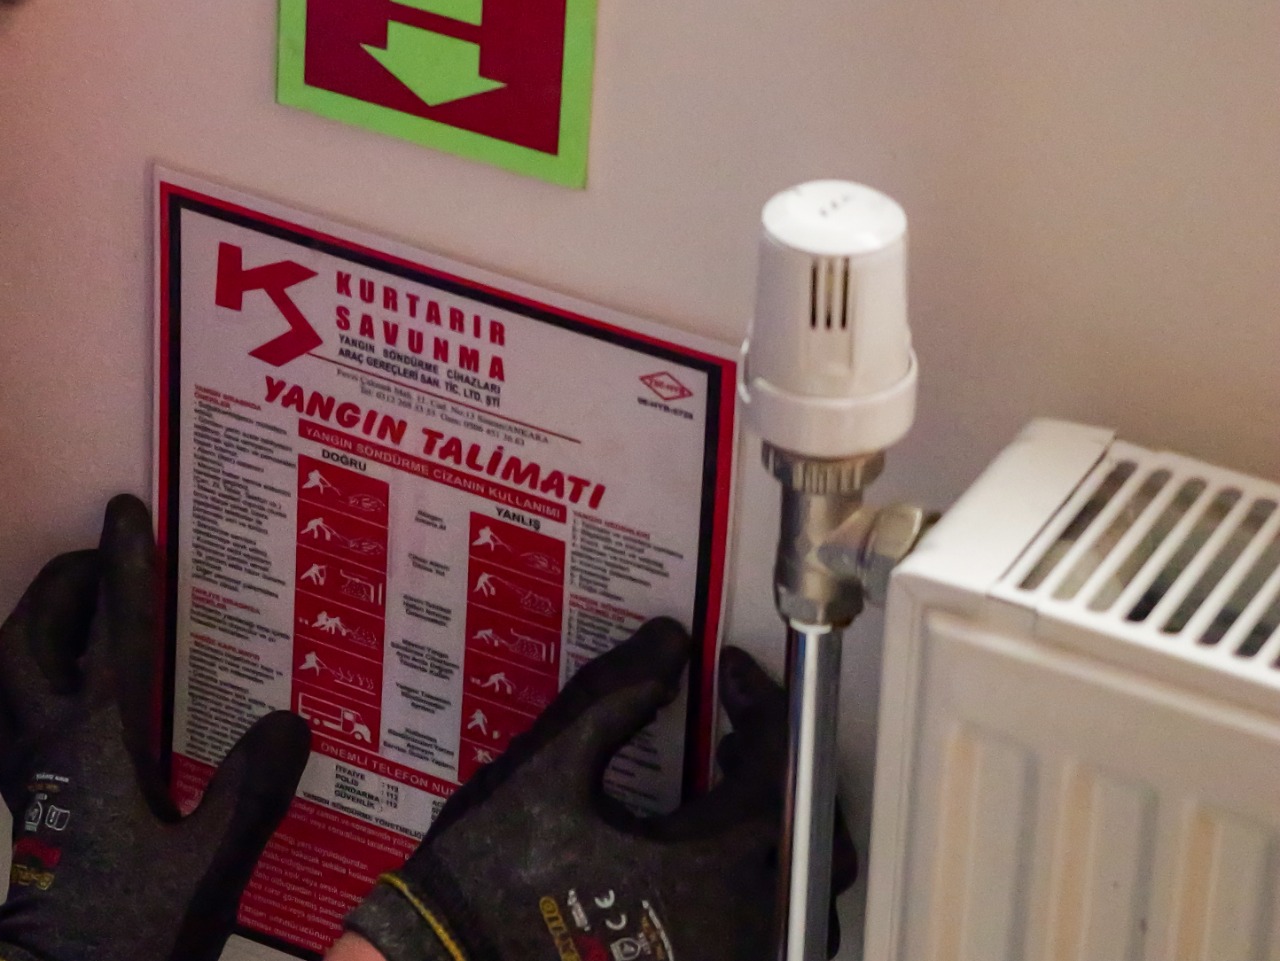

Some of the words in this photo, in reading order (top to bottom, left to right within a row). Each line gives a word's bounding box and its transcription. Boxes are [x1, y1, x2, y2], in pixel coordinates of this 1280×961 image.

[336, 271, 505, 346] KURTARIR
[336, 306, 505, 381] SAVUNMA
[339, 334, 375, 353] YANGIN
[338, 348, 363, 364] ARAÇ
[264, 376, 408, 446] YANGIN
[421, 426, 606, 510] TALİMATI
[305, 426, 353, 452] YANGIN
[356, 441, 430, 477] SÖNDÜRME
[488, 482, 561, 518] KULLANIMI
[321, 447, 367, 472] DOĞRU
[495, 506, 541, 532] YANLIŞ
[320, 741, 367, 766] ÖNEMLİ
[371, 758, 428, 788] TELEFON
